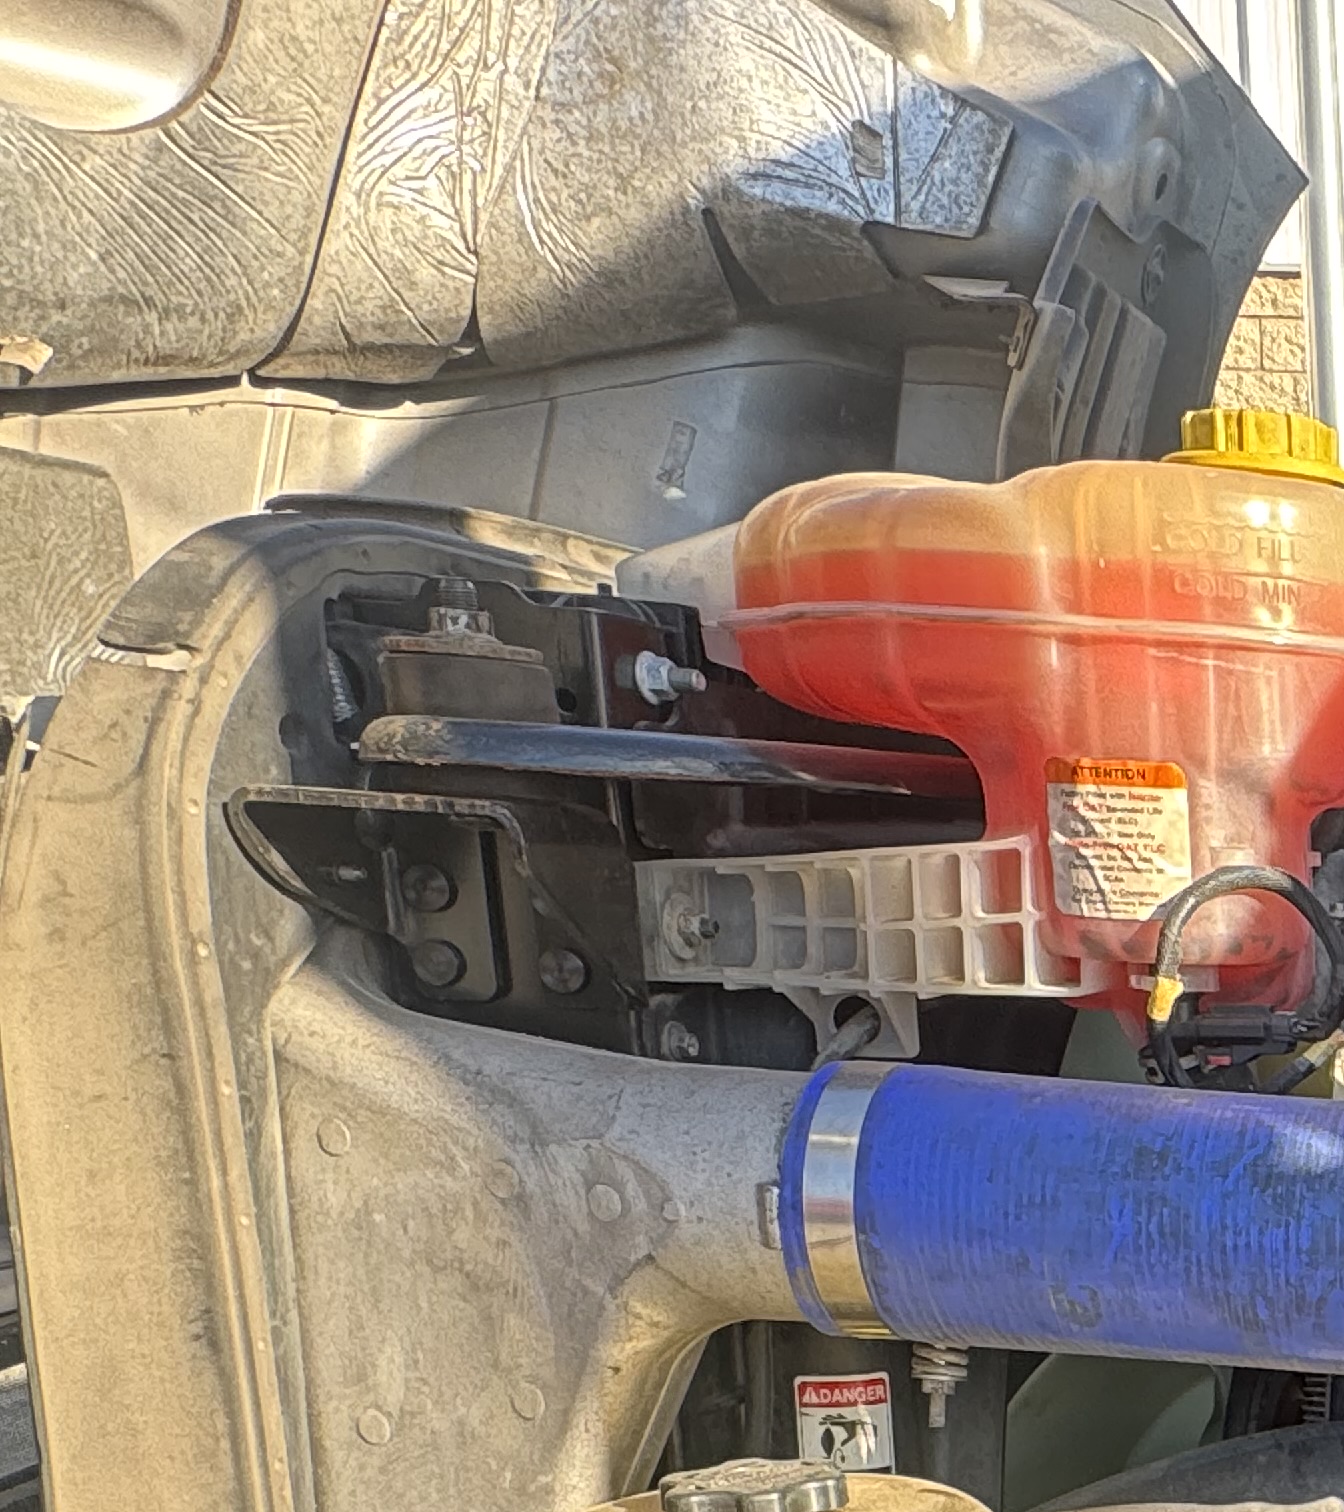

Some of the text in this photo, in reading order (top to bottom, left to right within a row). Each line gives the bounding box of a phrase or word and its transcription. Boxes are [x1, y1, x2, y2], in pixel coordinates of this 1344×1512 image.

[1166, 526, 1243, 556] COLD
[1173, 571, 1301, 606] COLD MIN
[1071, 765, 1146, 781] ATTENTION
[820, 1384, 886, 1404] DANGER
